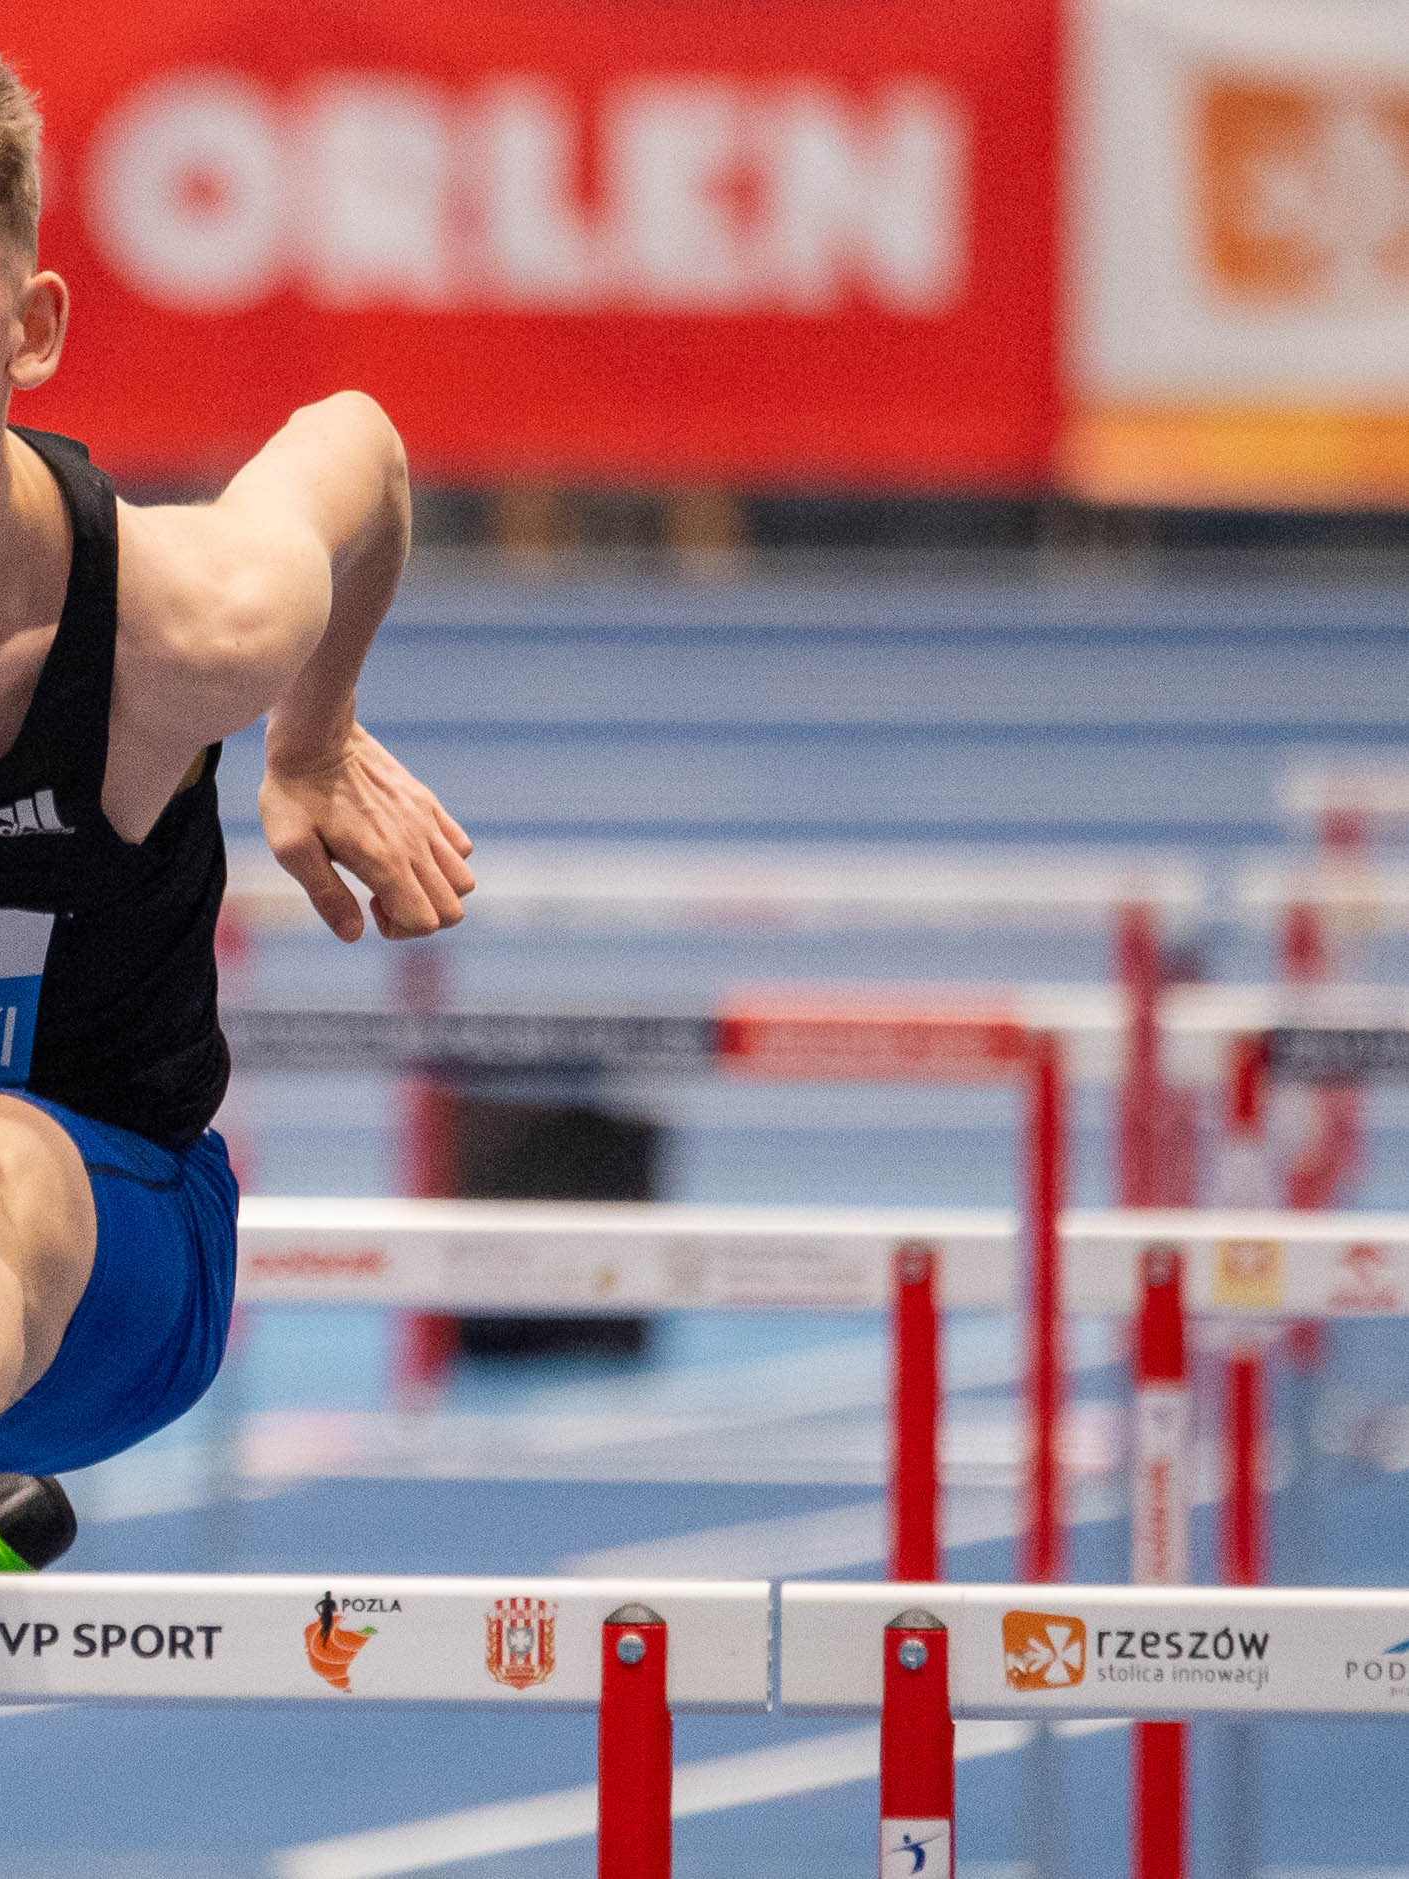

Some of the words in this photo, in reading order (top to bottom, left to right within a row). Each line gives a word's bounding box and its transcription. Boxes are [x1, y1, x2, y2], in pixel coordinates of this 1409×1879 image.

[95, 80, 960, 304] ORLEN
[342, 1598, 403, 1613] POZLA
[72, 1623, 222, 1660] SPORT
[1097, 1625, 1270, 1661] rzeszów
[1097, 1663, 1164, 1683] stolica
[1172, 1664, 1269, 1691] innowacji
[1345, 1661, 1406, 1681] POD
